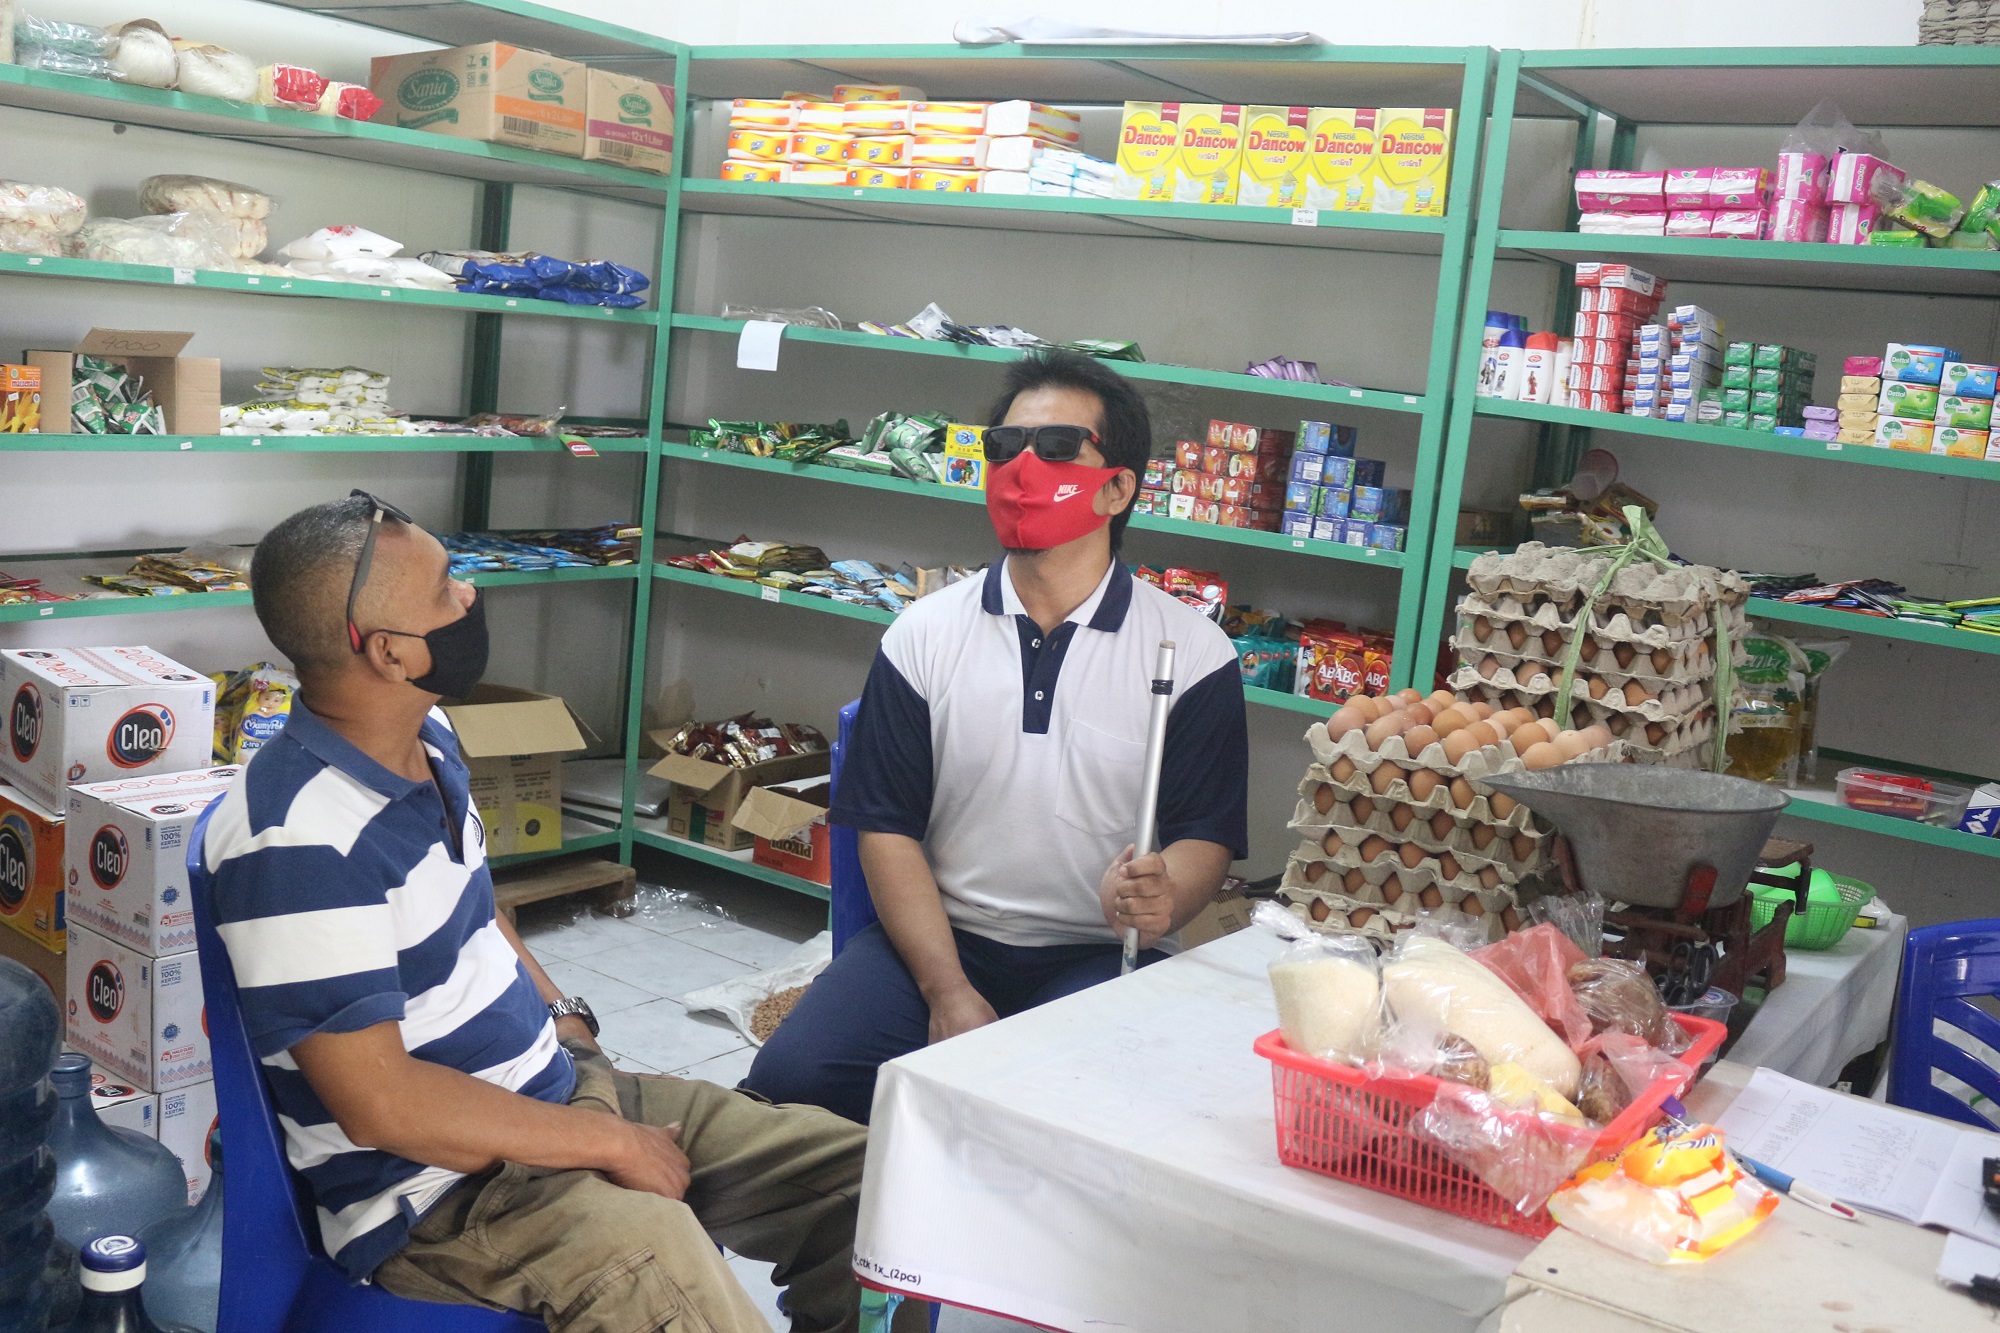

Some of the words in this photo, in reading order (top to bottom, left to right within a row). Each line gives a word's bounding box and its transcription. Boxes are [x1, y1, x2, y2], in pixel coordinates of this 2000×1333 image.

[408, 76, 447, 99] Sania
[1124, 126, 1177, 146] Dancow
[1184, 128, 1238, 149] Dancow
[1249, 131, 1306, 152] Dancow
[1315, 133, 1373, 154] Dancow
[1382, 134, 1443, 155] Dancow
[1892, 355, 1910, 364] Dettol
[1950, 369, 1967, 377] Dettol
[1887, 389, 1906, 398] Dettol
[1941, 433, 1958, 441] Dettol
[1057, 484, 1079, 494] NIKE
[1172, 577, 1195, 585] GRATIS
[1318, 664, 1336, 678] AB
[1334, 668, 1359, 685] ABC
[1365, 672, 1388, 687] ABC
[16, 702, 36, 744] Cleo
[121, 723, 162, 751] Cleo
[161, 832, 181, 840] 100%
[97, 841, 120, 876] Cleo
[161, 970, 181, 979] 100%
[161, 976, 181, 984] KERTAS
[93, 974, 117, 1011] Cleo
[165, 1101, 185, 1110] 100%
[165, 1107, 185, 1115] KERTAS
[873, 1263, 921, 1285] 1x_(2pcs)
